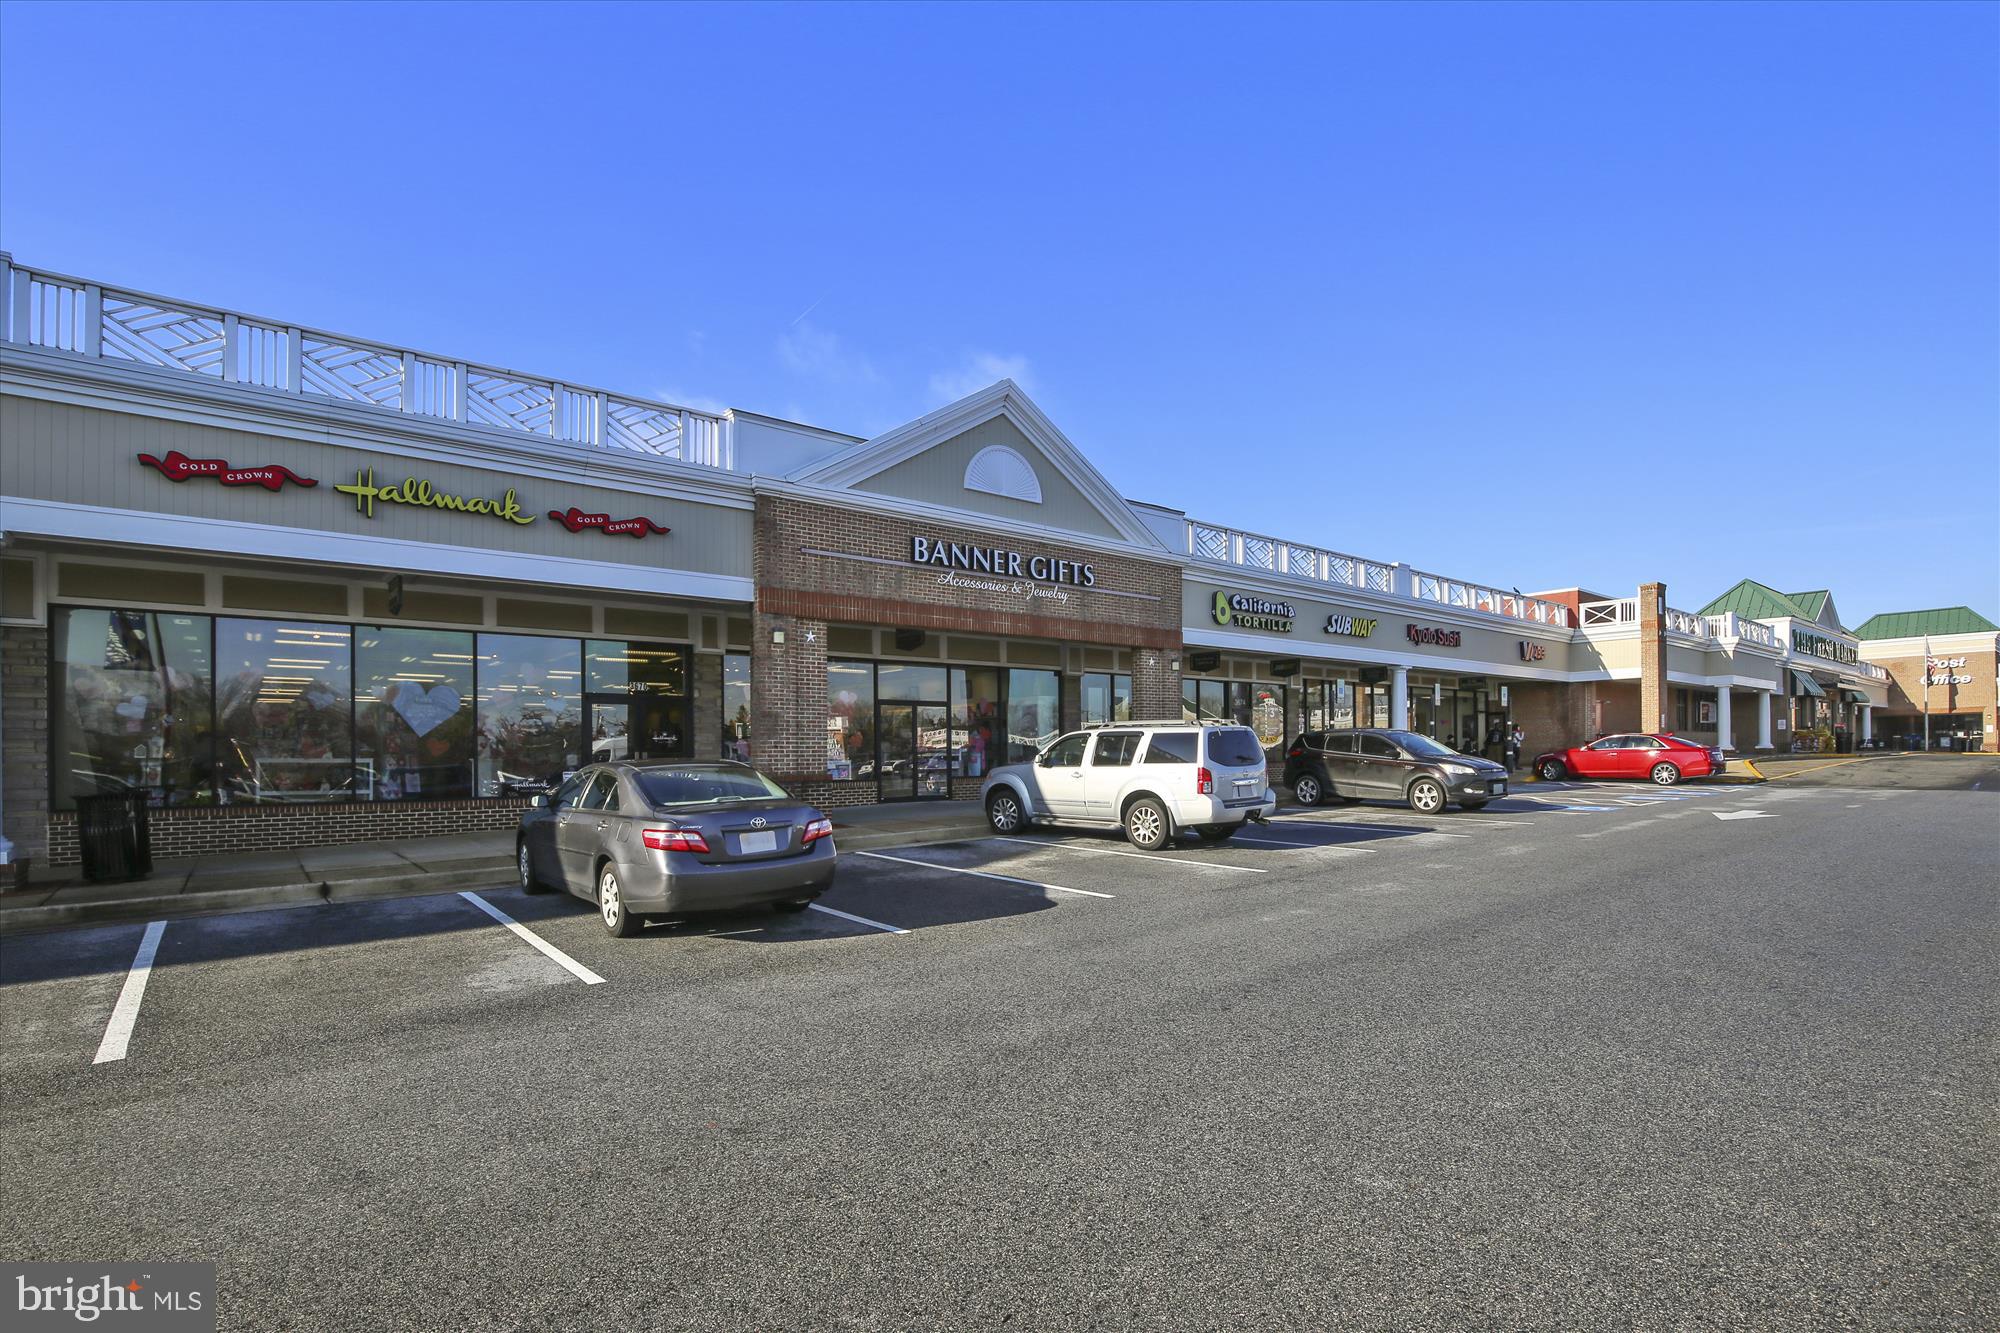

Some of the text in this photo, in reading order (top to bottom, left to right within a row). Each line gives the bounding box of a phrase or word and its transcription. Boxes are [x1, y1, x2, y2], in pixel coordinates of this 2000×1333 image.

[179, 462, 218, 471] GOLD
[226, 472, 273, 481] CROWN
[334, 464, 536, 525] Hallmark
[608, 522, 641, 531] CROWN
[913, 536, 1096, 587] BANNER GIFTS
[937, 570, 1070, 605] Accessories & Jewelry
[1232, 594, 1296, 619] California
[1236, 614, 1294, 633] TORTILLA
[1326, 614, 1378, 638] SUBWAY
[1409, 624, 1462, 647] Kyoto Sushi
